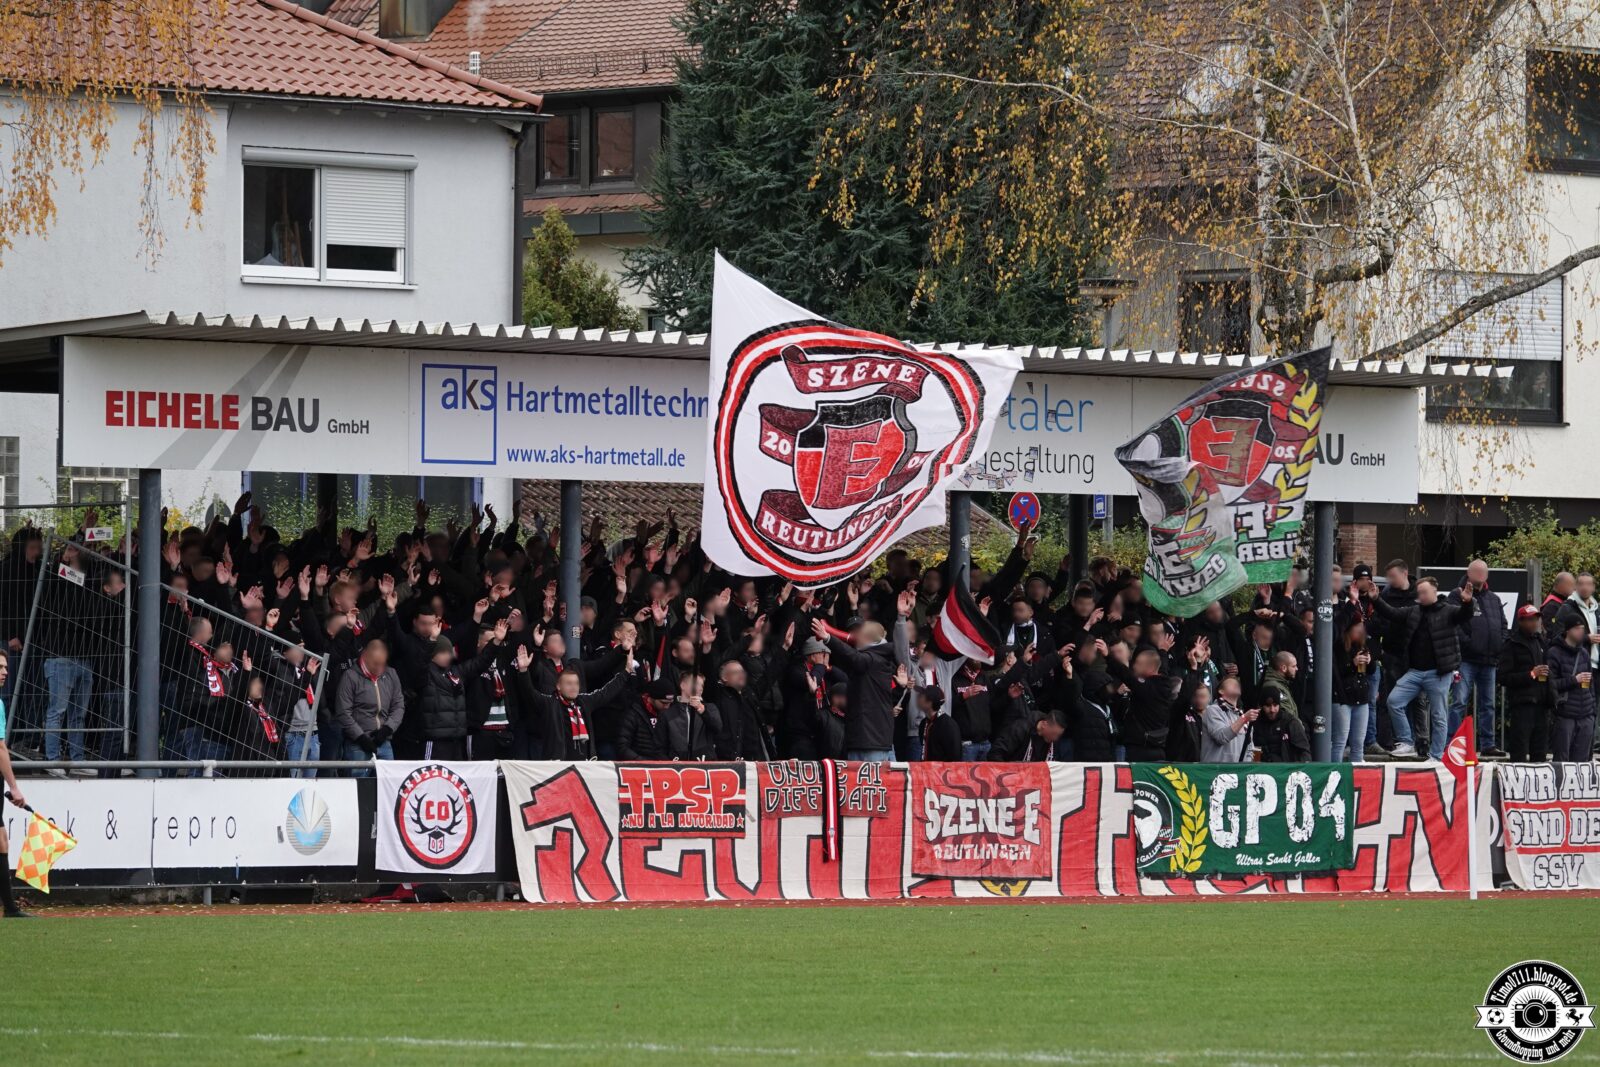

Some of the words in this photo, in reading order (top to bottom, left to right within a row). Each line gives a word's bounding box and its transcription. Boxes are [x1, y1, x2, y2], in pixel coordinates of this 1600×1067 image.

[807, 362, 917, 388] SZENE
[441, 369, 497, 411] aks
[506, 380, 708, 418] Hartmetalltechn
[105, 390, 240, 430] EICHELE
[251, 396, 320, 433] BAU
[327, 419, 370, 434] GmbH
[506, 444, 686, 467] www.aks-hartmetall.de
[763, 431, 792, 456] 20
[1350, 452, 1385, 466] GmbH
[811, 421, 883, 510] E
[766, 759, 848, 786] ONOE
[857, 761, 882, 786] AI
[1500, 763, 1556, 801] WIR
[619, 767, 740, 815] TPSP
[765, 786, 887, 812] DIFFATI
[1135, 789, 1159, 804] POWER
[628, 813, 644, 828] NO
[648, 813, 656, 828] A
[661, 813, 674, 828] LA
[924, 787, 1016, 842] SZENE
[1023, 788, 1042, 845] E
[1208, 771, 1346, 849] GP04
[105, 809, 118, 840] &
[152, 815, 237, 846] repro
[1507, 810, 1565, 847] SIND
[1235, 853, 1264, 866] Ultras
[1266, 852, 1292, 866] Sankt
[1294, 851, 1321, 867] Gallen
[1533, 854, 1584, 888] SSV
